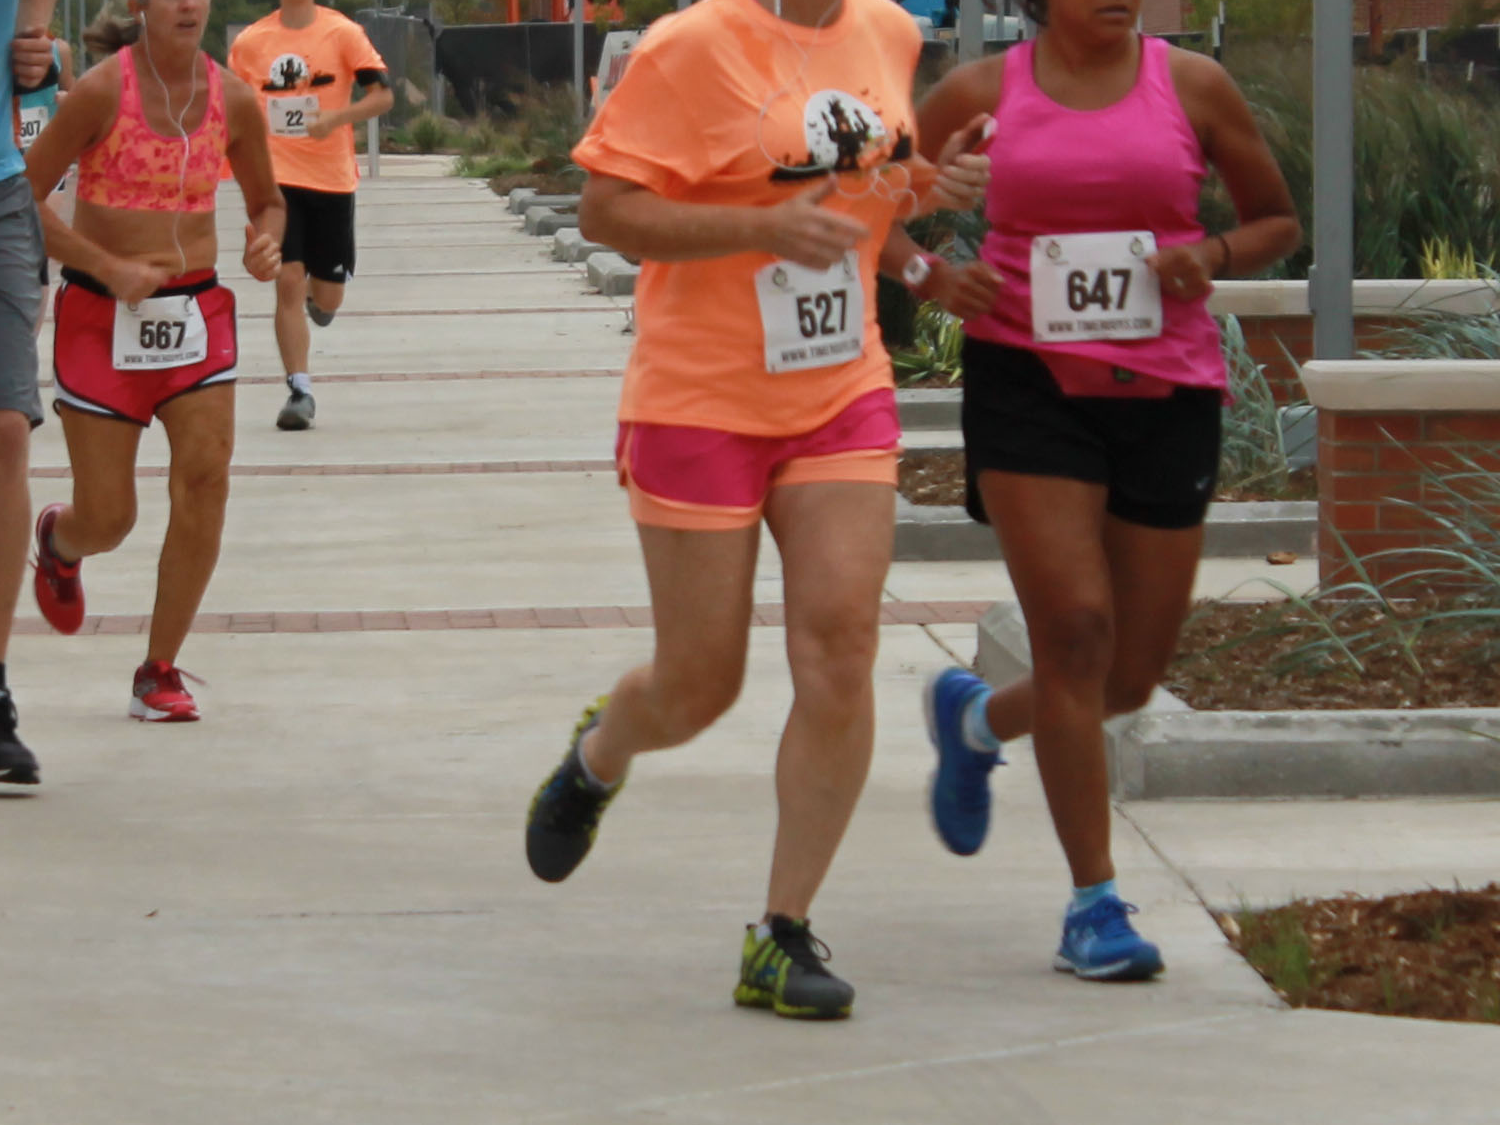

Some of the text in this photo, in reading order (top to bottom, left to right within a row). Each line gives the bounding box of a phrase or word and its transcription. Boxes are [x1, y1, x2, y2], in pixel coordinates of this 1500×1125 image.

[285, 110, 304, 126] 22
[1066, 268, 1133, 312] 647
[796, 288, 848, 339] 527
[140, 320, 187, 350] 567
